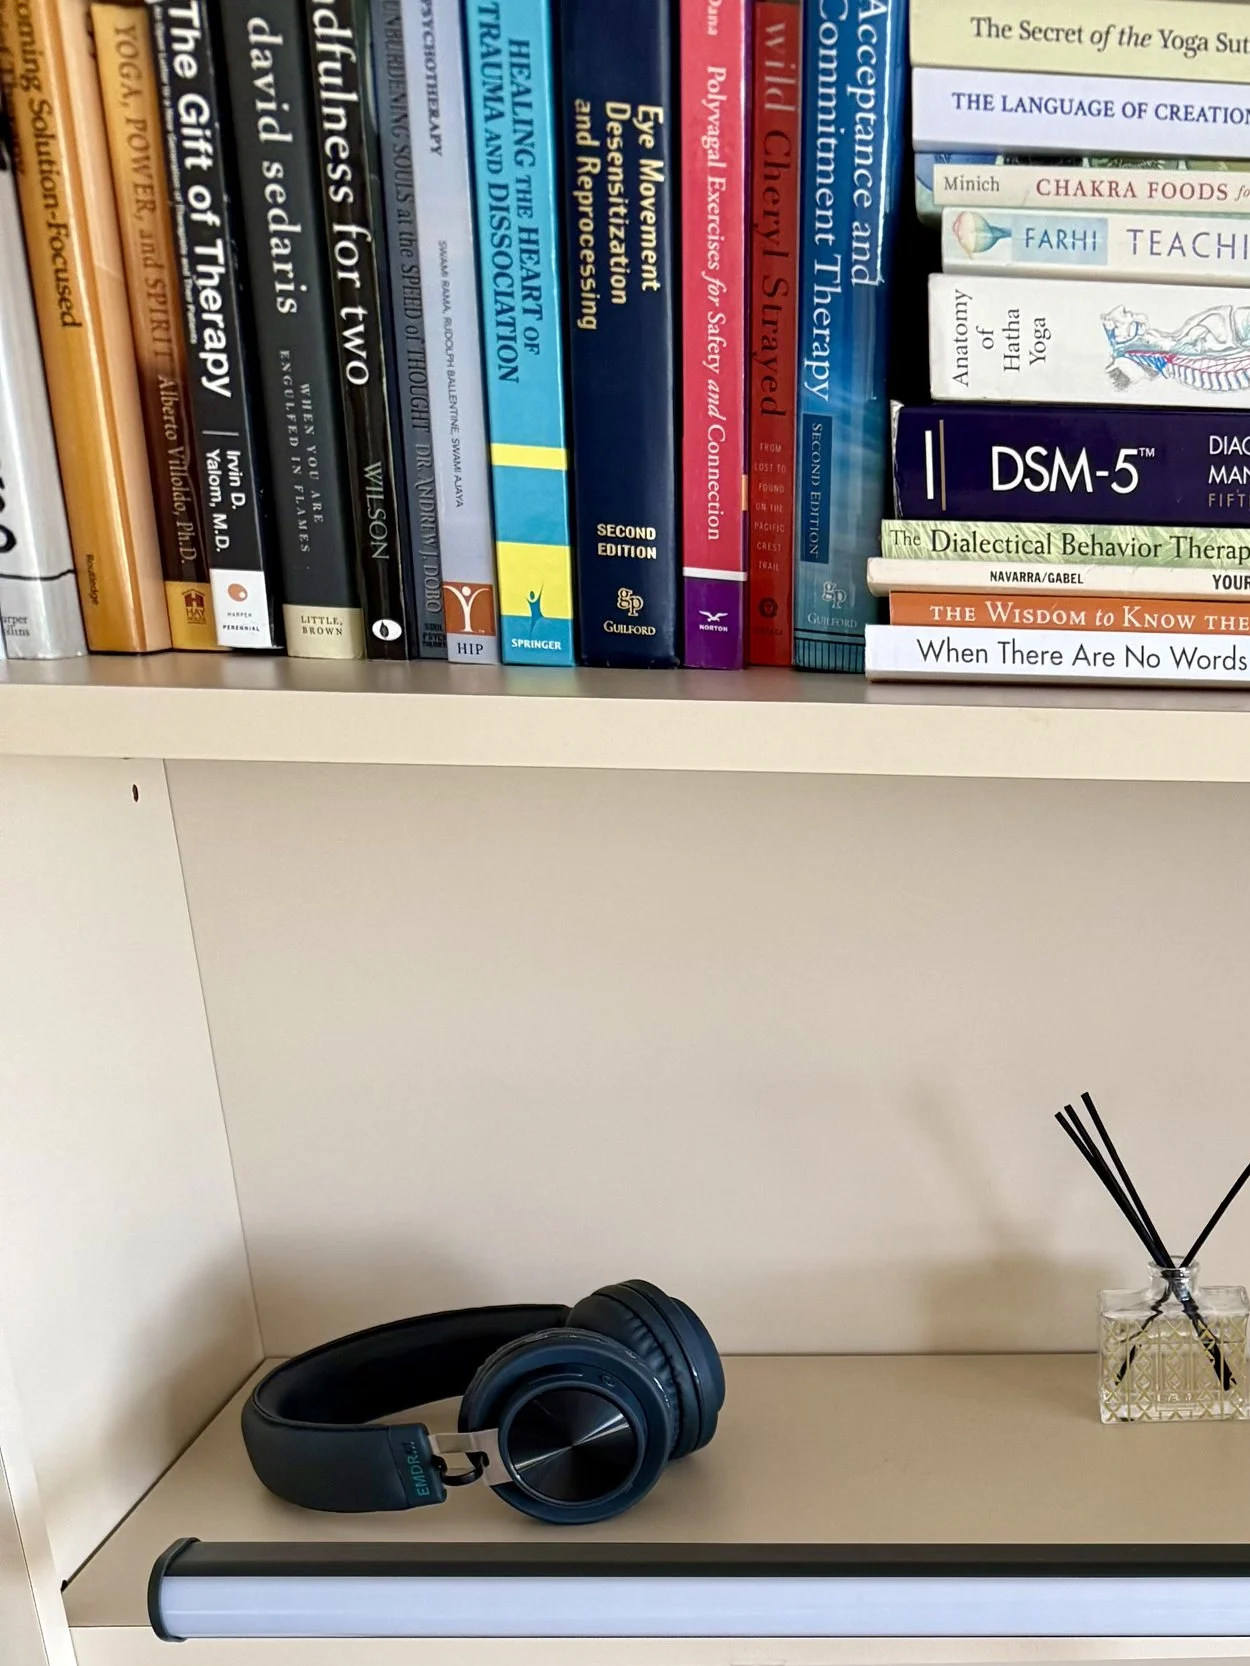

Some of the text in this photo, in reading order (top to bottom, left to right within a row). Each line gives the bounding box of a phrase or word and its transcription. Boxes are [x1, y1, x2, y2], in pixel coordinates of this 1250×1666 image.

[970, 16, 1013, 41] The
[1018, 20, 1083, 45] Secret
[1089, 24, 1117, 53] of
[1118, 24, 1152, 49] the
[1156, 28, 1209, 60] Yoga
[951, 92, 995, 113] THE
[1000, 94, 1116, 119] LANGUAGE
[1121, 101, 1149, 121] OF
[247, 16, 308, 315] david sedaris
[846, 0, 887, 287] Acceptance and
[114, 24, 173, 358] YOGA, POWER, and SPIRIT
[168, 1, 232, 399] The Gift of Therapy
[311, 0, 372, 386] dfulness for two
[478, 2, 519, 384] TRAUMA AND DISSOCIATION
[508, 38, 543, 356] HEALING THE HEART OF
[572, 98, 601, 330] and Reprocessing
[604, 101, 632, 305] Desensitization
[634, 103, 666, 292] Eye Movement
[804, 0, 848, 401] Commitment Therapy
[943, 175, 1000, 194] Minich
[1035, 178, 1138, 200] CHAKRA
[1148, 181, 1229, 202] FOODS
[1025, 227, 1098, 252] FARHI
[701, 65, 728, 541] Polyvagal Exercises for Safety and Connection
[951, 289, 974, 388] Anatomy
[976, 325, 996, 351] of
[1003, 308, 1020, 373] Hatha
[1029, 316, 1052, 367] Yoga
[206, 448, 230, 553] Yalom, M.D.
[226, 449, 246, 512] Irvin D.
[363, 460, 390, 561] WILSON
[809, 423, 824, 556] SECOND EDITION
[597, 523, 657, 541] SECOND
[597, 542, 657, 560] EDITION
[889, 528, 922, 548] The
[930, 528, 1052, 556] Dialectical
[1061, 532, 1163, 560] Behavior
[990, 570, 1084, 586] NAVARRA/GABEL
[300, 615, 344, 626] LITTLE,
[302, 625, 344, 637] BROWN
[457, 642, 484, 655] HIP
[511, 638, 562, 650] SPRINGER
[699, 624, 729, 633] NORTON
[916, 637, 1248, 672] When There Are No Words
